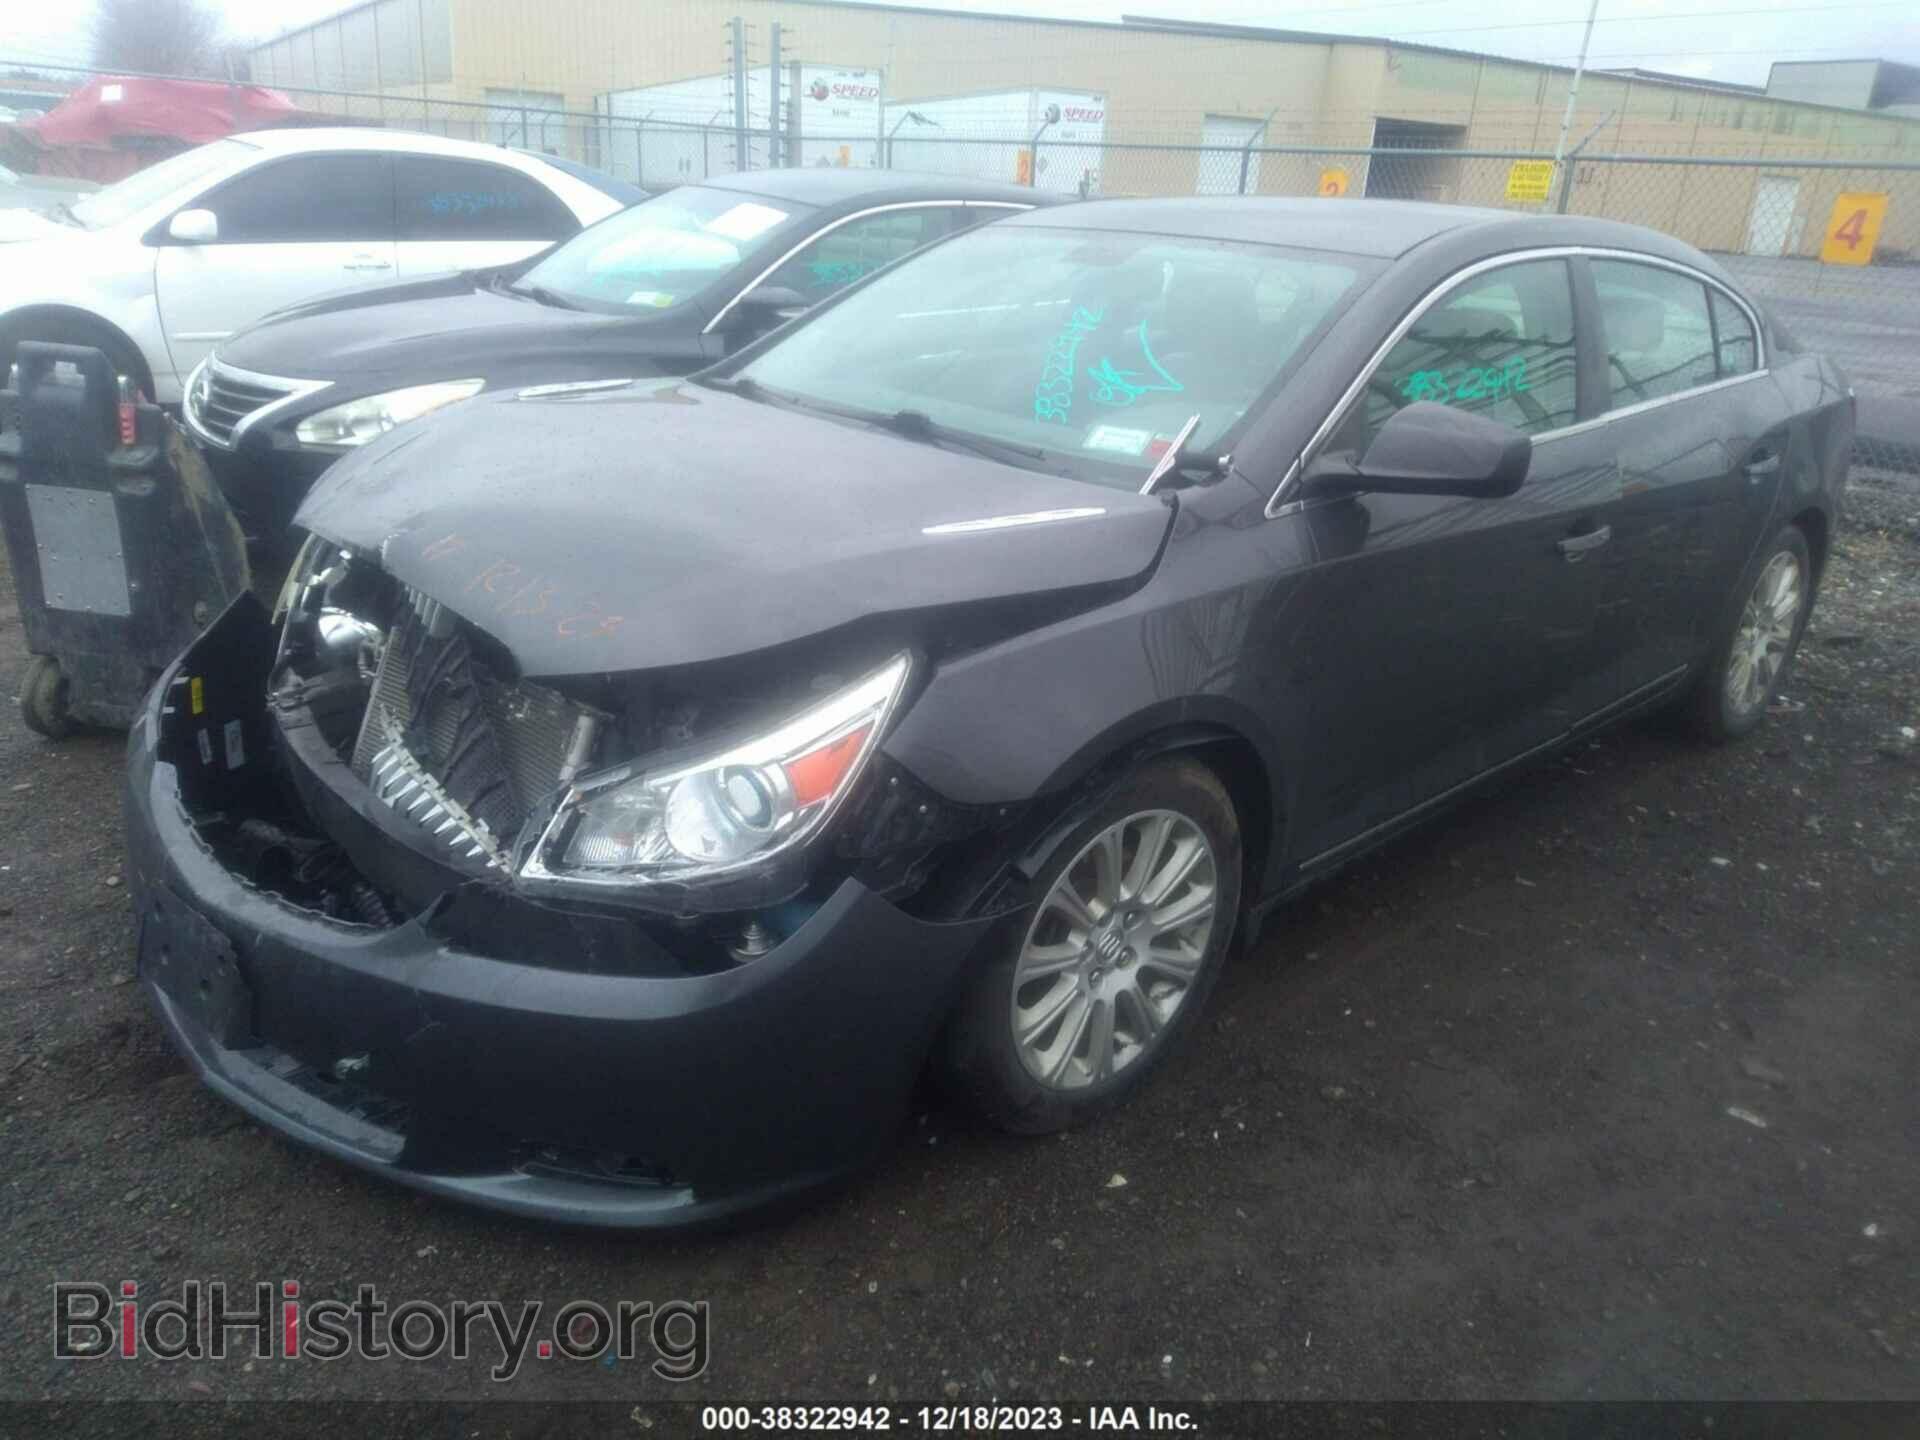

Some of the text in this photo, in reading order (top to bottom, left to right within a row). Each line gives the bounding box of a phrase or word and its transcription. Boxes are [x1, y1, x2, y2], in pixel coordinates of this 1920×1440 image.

[831, 83, 879, 98] SPEED
[1063, 107, 1104, 121] SPEED
[1834, 208, 1868, 252] 4
